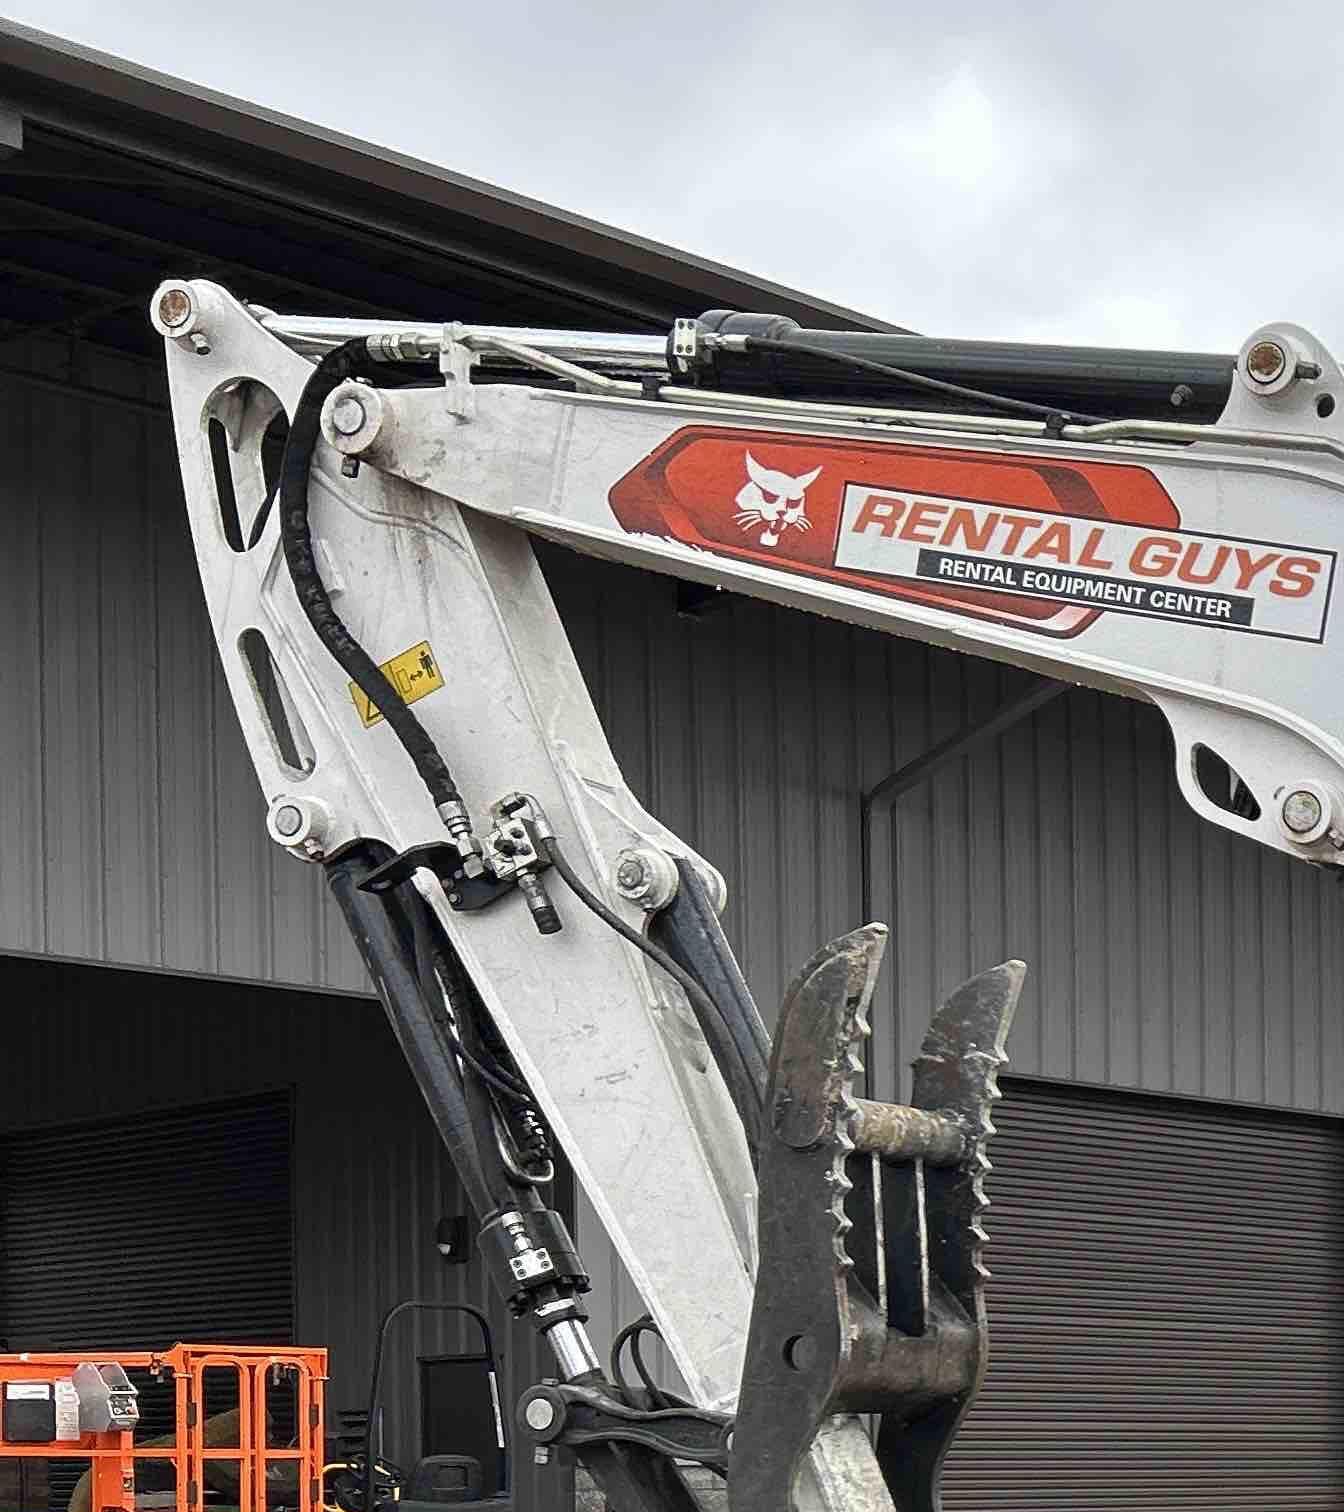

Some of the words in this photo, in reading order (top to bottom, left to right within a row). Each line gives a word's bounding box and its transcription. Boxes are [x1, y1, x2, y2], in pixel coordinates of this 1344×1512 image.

[853, 495, 1113, 569] RENTAL
[1130, 536, 1321, 598] GUYS
[939, 558, 1017, 587] RENTAL
[1023, 571, 1145, 604] EQUIPMENT
[1150, 590, 1231, 617] CENTER
